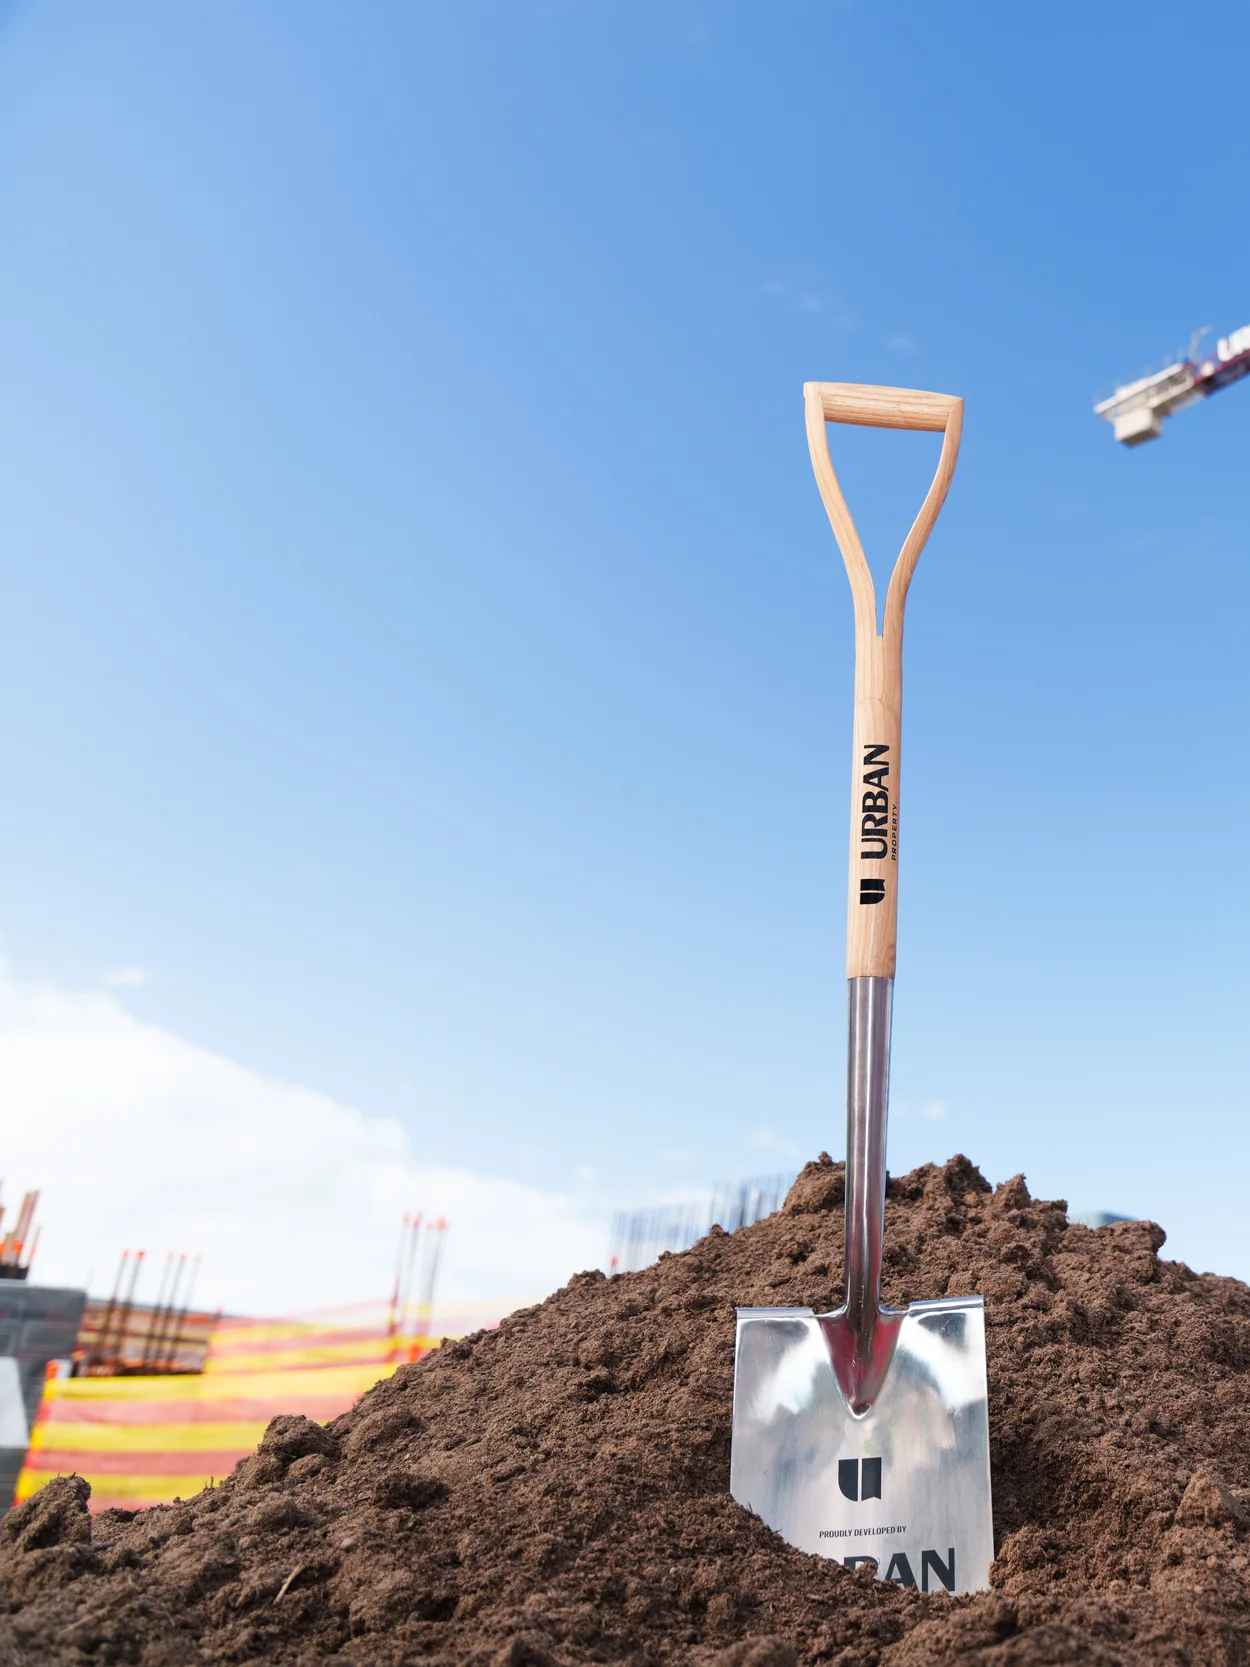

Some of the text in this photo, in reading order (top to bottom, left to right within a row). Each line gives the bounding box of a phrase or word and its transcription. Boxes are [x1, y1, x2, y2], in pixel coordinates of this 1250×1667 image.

[861, 744, 890, 859] URBAN
[819, 1525, 907, 1539] PROUDLY DEVELOPED BY
